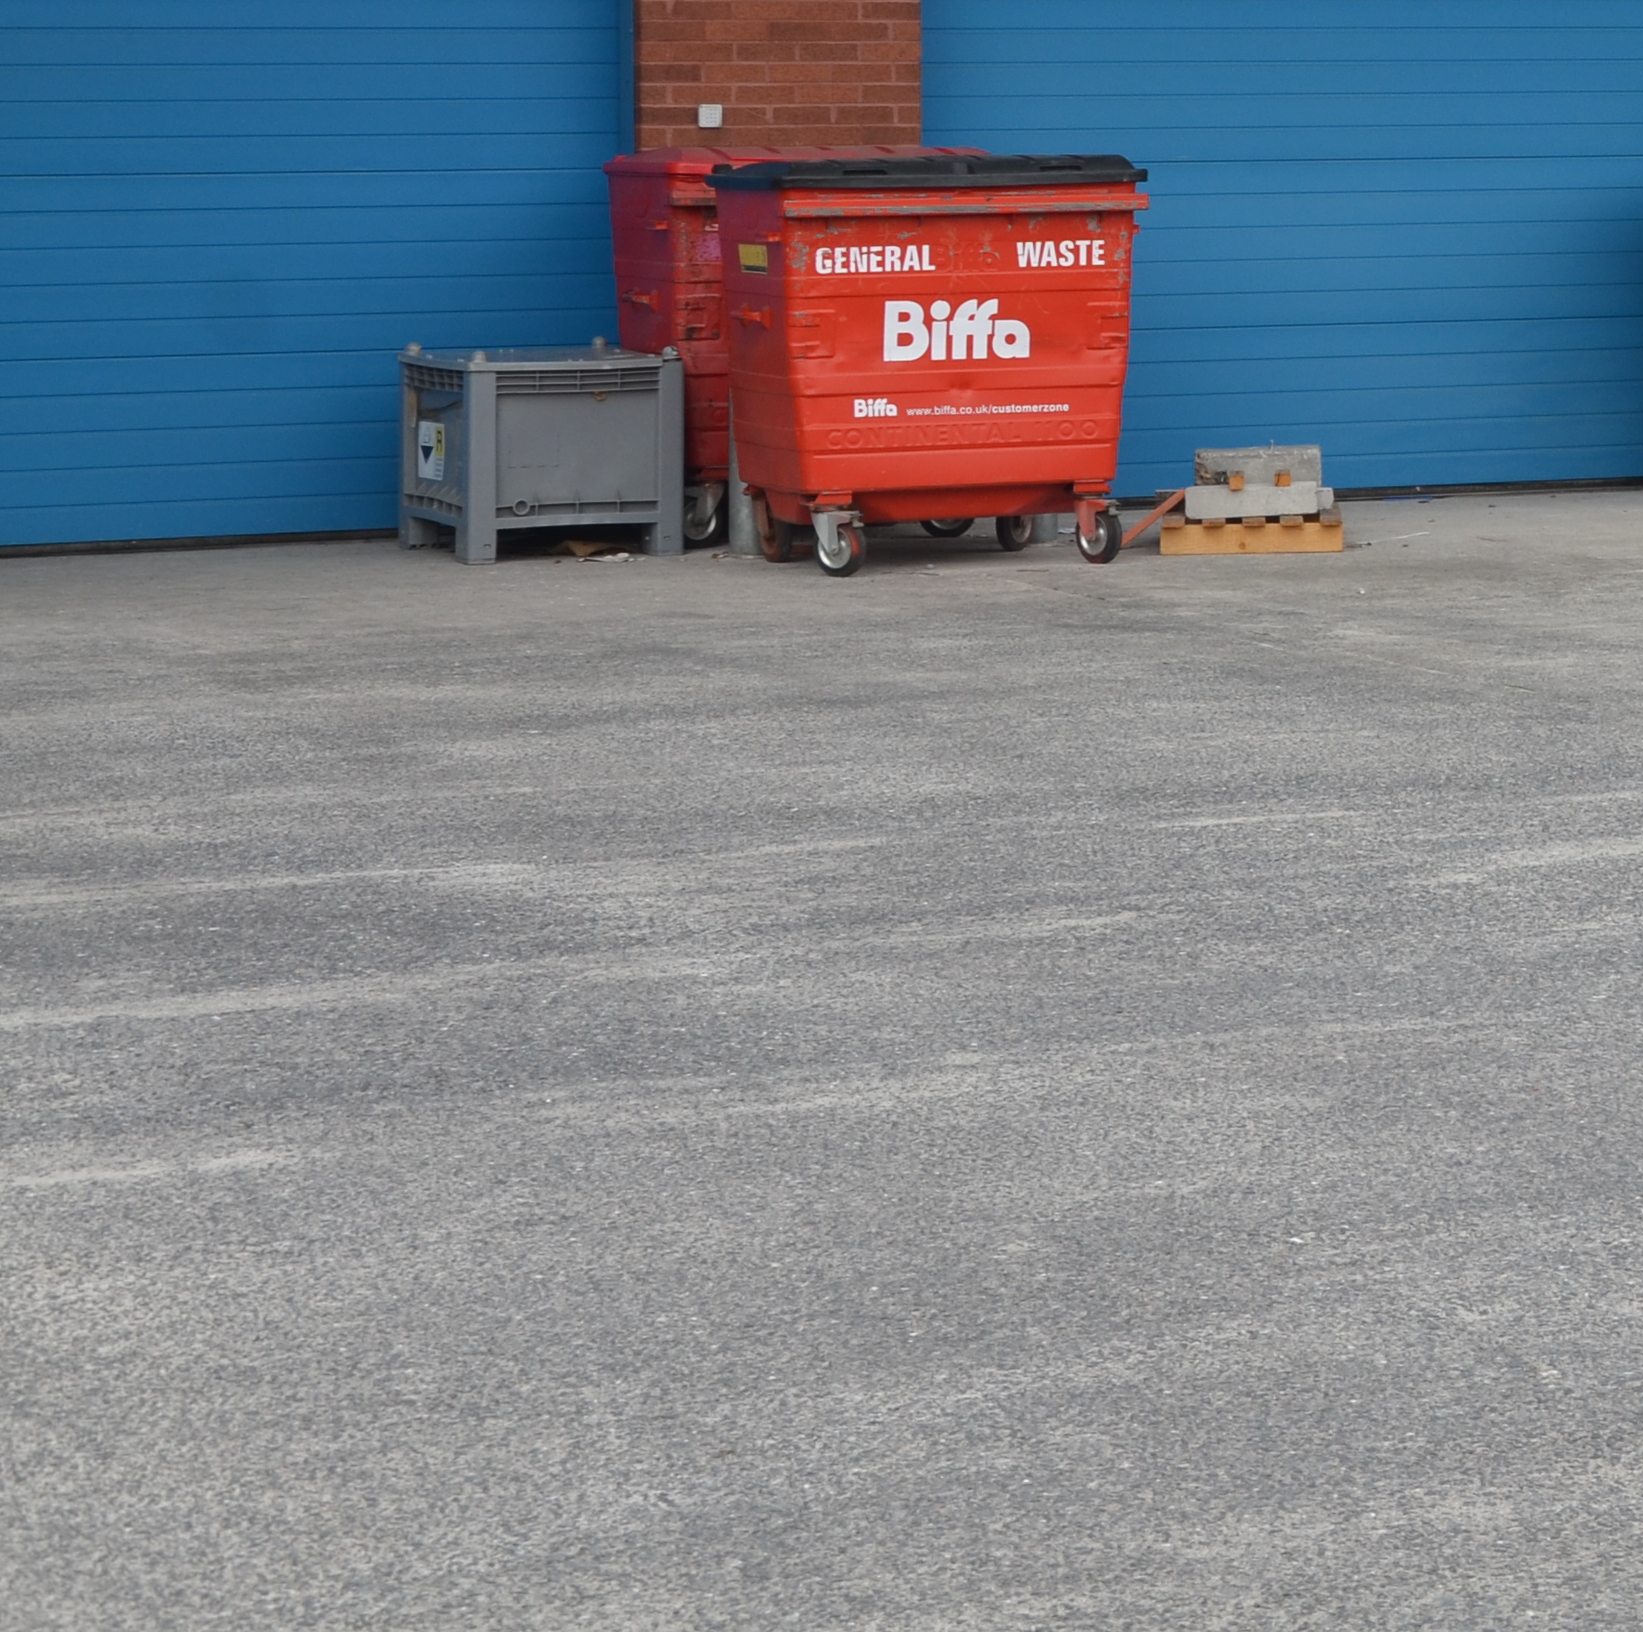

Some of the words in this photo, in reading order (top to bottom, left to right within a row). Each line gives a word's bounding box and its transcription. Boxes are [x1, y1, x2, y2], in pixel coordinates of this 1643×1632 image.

[814, 244, 936, 274] GENERAL
[1016, 239, 1105, 268] WASTE
[882, 298, 1031, 362] Biffa
[853, 398, 898, 418] Biffa
[906, 402, 1070, 416] www.biffa.co.uk/customerzone
